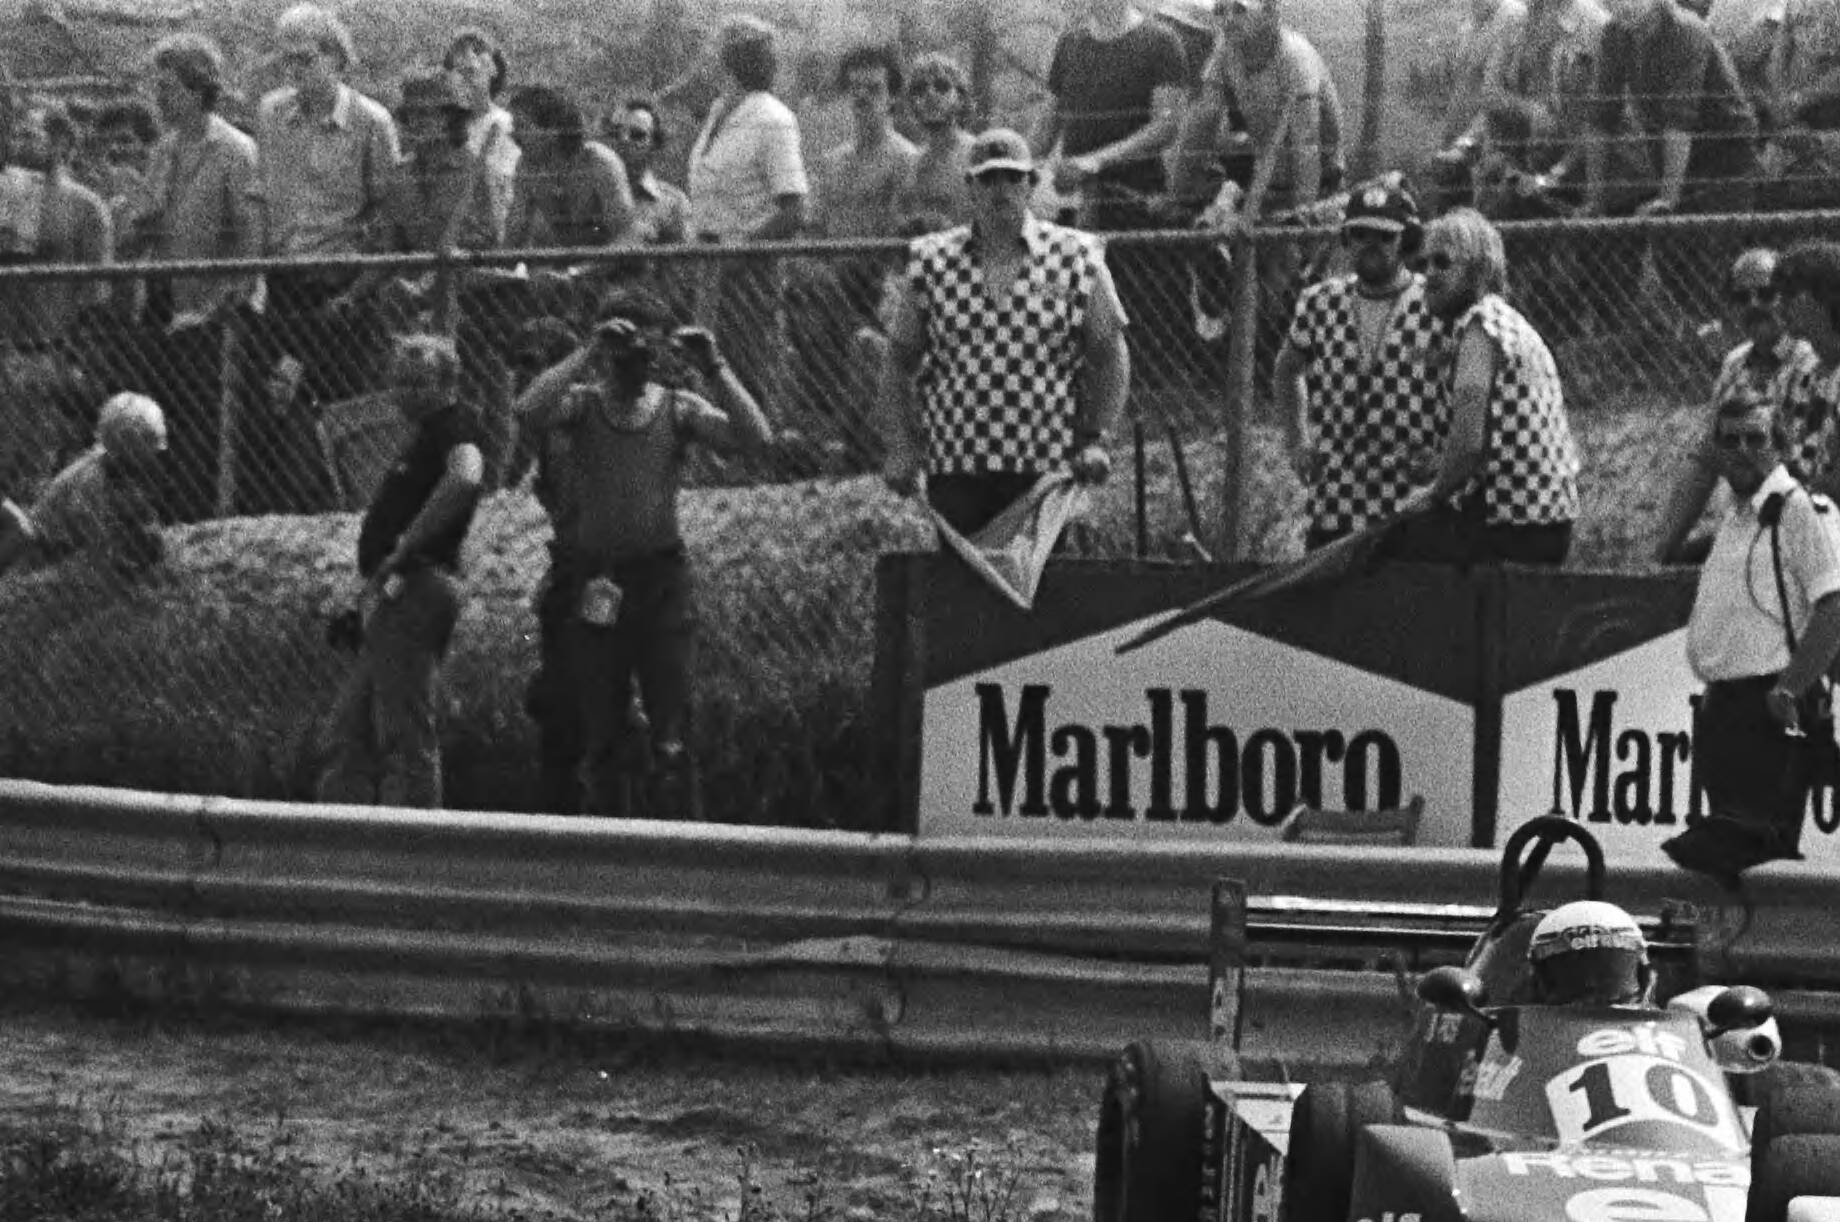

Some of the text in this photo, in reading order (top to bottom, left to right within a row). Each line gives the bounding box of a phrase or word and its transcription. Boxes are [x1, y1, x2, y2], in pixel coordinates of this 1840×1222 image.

[973, 683, 1401, 826] Marlboro
[1577, 1022, 1686, 1061] elf
[1569, 1062, 1719, 1132] 10
[1502, 1151, 1751, 1186] Rena
